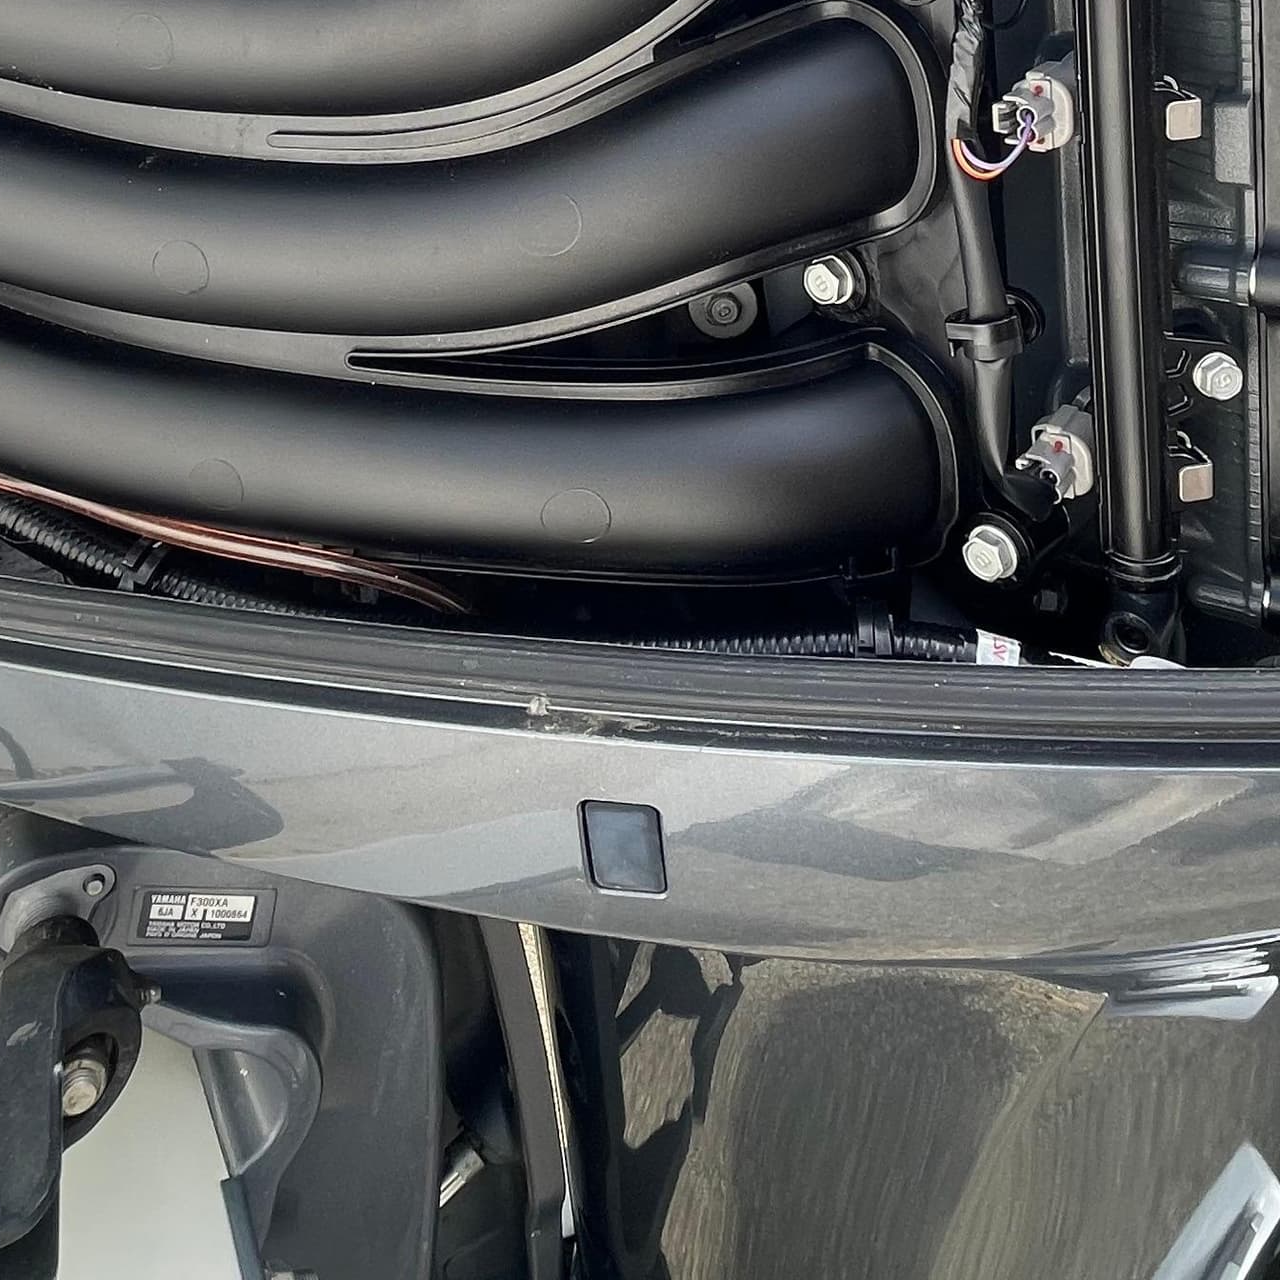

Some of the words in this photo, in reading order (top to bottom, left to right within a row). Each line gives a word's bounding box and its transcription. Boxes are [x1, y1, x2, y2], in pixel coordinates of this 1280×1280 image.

[151, 894, 186, 905] YAMAHA
[190, 897, 228, 907] F300XA
[191, 908, 197, 917] X
